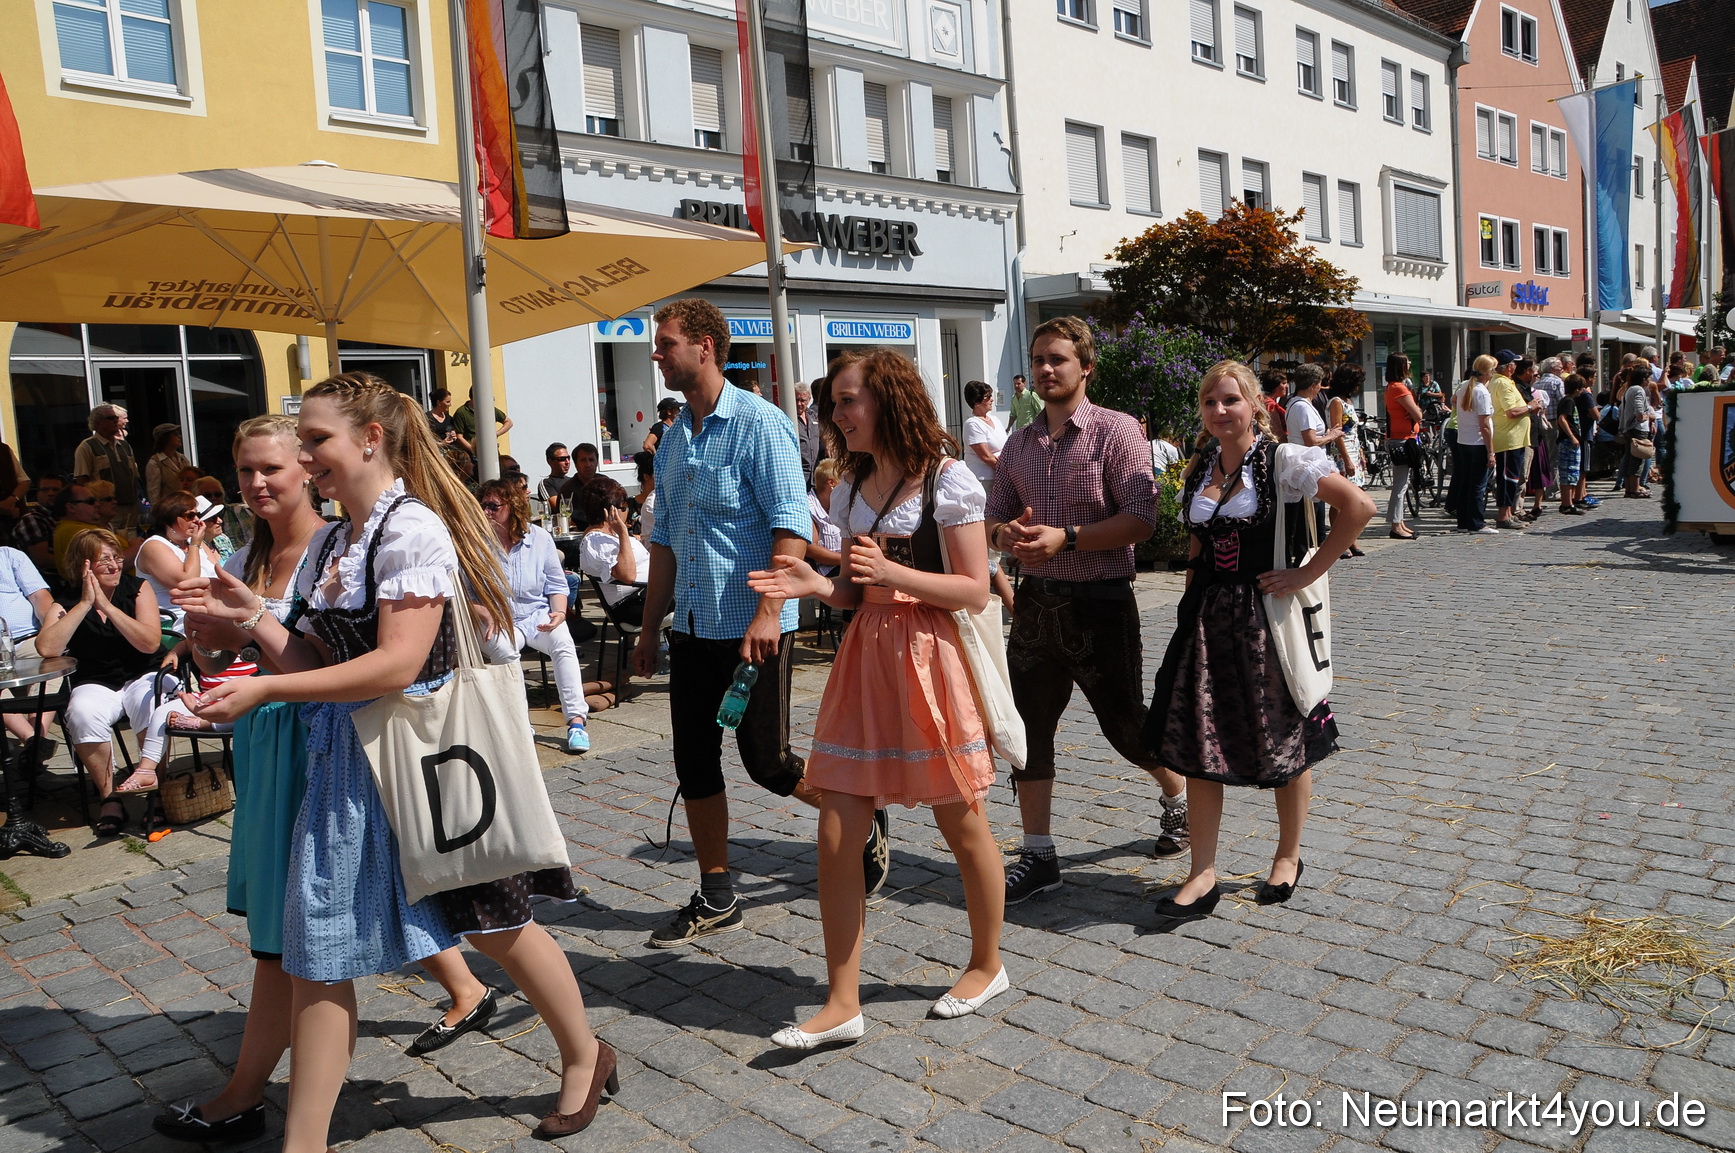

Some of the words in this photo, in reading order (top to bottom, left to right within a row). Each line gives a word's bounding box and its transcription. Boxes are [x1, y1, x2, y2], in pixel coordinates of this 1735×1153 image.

[680, 198, 817, 243] BRILN
[815, 211, 924, 256] WEBER
[746, 320, 774, 335] WEB
[831, 322, 872, 337] BRILLEN
[873, 323, 908, 338] WEBER
[450, 351, 470, 367] 24
[751, 361, 767, 369] Linie
[1302, 602, 1330, 672] E
[420, 744, 497, 855] D
